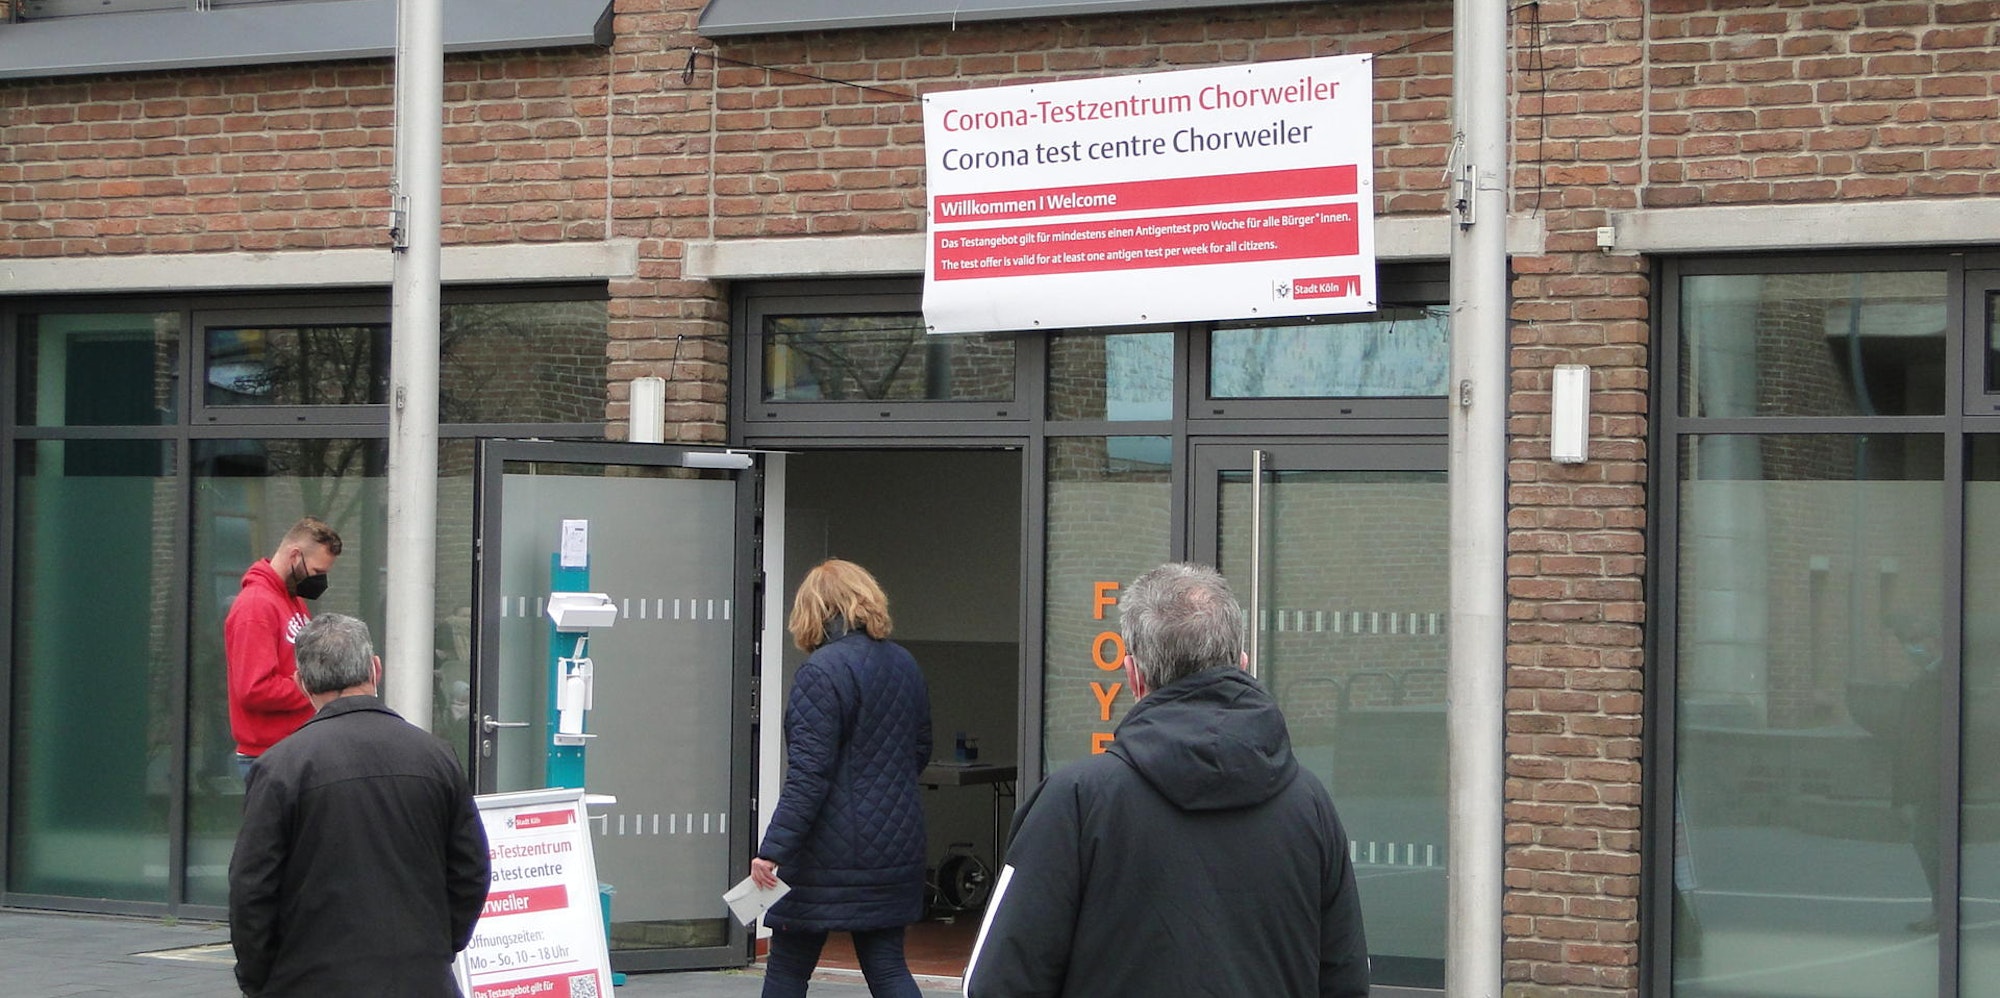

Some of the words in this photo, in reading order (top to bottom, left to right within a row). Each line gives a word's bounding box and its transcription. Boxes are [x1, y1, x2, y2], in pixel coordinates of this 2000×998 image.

[943, 94, 1191, 132] Corona-Testzentrum
[1199, 76, 1340, 110] Chorweiler
[943, 148, 1029, 171] Corona
[1035, 140, 1082, 164] test
[1088, 135, 1166, 160] centre
[1173, 119, 1313, 153] Chorweiler
[941, 199, 1036, 217] Willkommen
[1047, 192, 1117, 210] Welcome
[941, 238, 959, 249] Das
[960, 234, 1018, 248] Testangebot
[1020, 232, 1035, 246] gilt
[1037, 231, 1051, 243] für
[1052, 229, 1106, 242] mindestens
[1107, 227, 1134, 238] einen
[1135, 223, 1191, 238] Antigentest
[1192, 223, 1210, 235] pro
[1211, 218, 1245, 231] Woche
[1246, 217, 1261, 229] für
[1262, 215, 1280, 227] alle
[941, 259, 959, 270] The
[960, 259, 979, 269] test
[980, 256, 1002, 268] offer
[1003, 257, 1011, 267] is
[1012, 254, 1034, 266] valid
[1035, 253, 1051, 265] for
[1051, 254, 1062, 264] at
[1063, 252, 1086, 263] least
[1086, 252, 1105, 262] one
[1106, 248, 1143, 262] antigen
[1144, 247, 1163, 258] test
[1164, 247, 1182, 259] per
[1181, 243, 1208, 255] week
[1209, 242, 1225, 253] for
[1225, 241, 1237, 253] all
[1238, 239, 1278, 252] citizens.
[1294, 283, 1318, 295] Stadt
[1319, 282, 1340, 293] Köln
[488, 841, 572, 861] a-Testzentrum
[501, 866, 523, 881] test
[525, 863, 563, 879] centre
[470, 956, 488, 970] Mo
[498, 952, 515, 967] So,
[516, 949, 529, 964] 10
[538, 947, 551, 961] 18
[552, 944, 570, 959] Uhr
